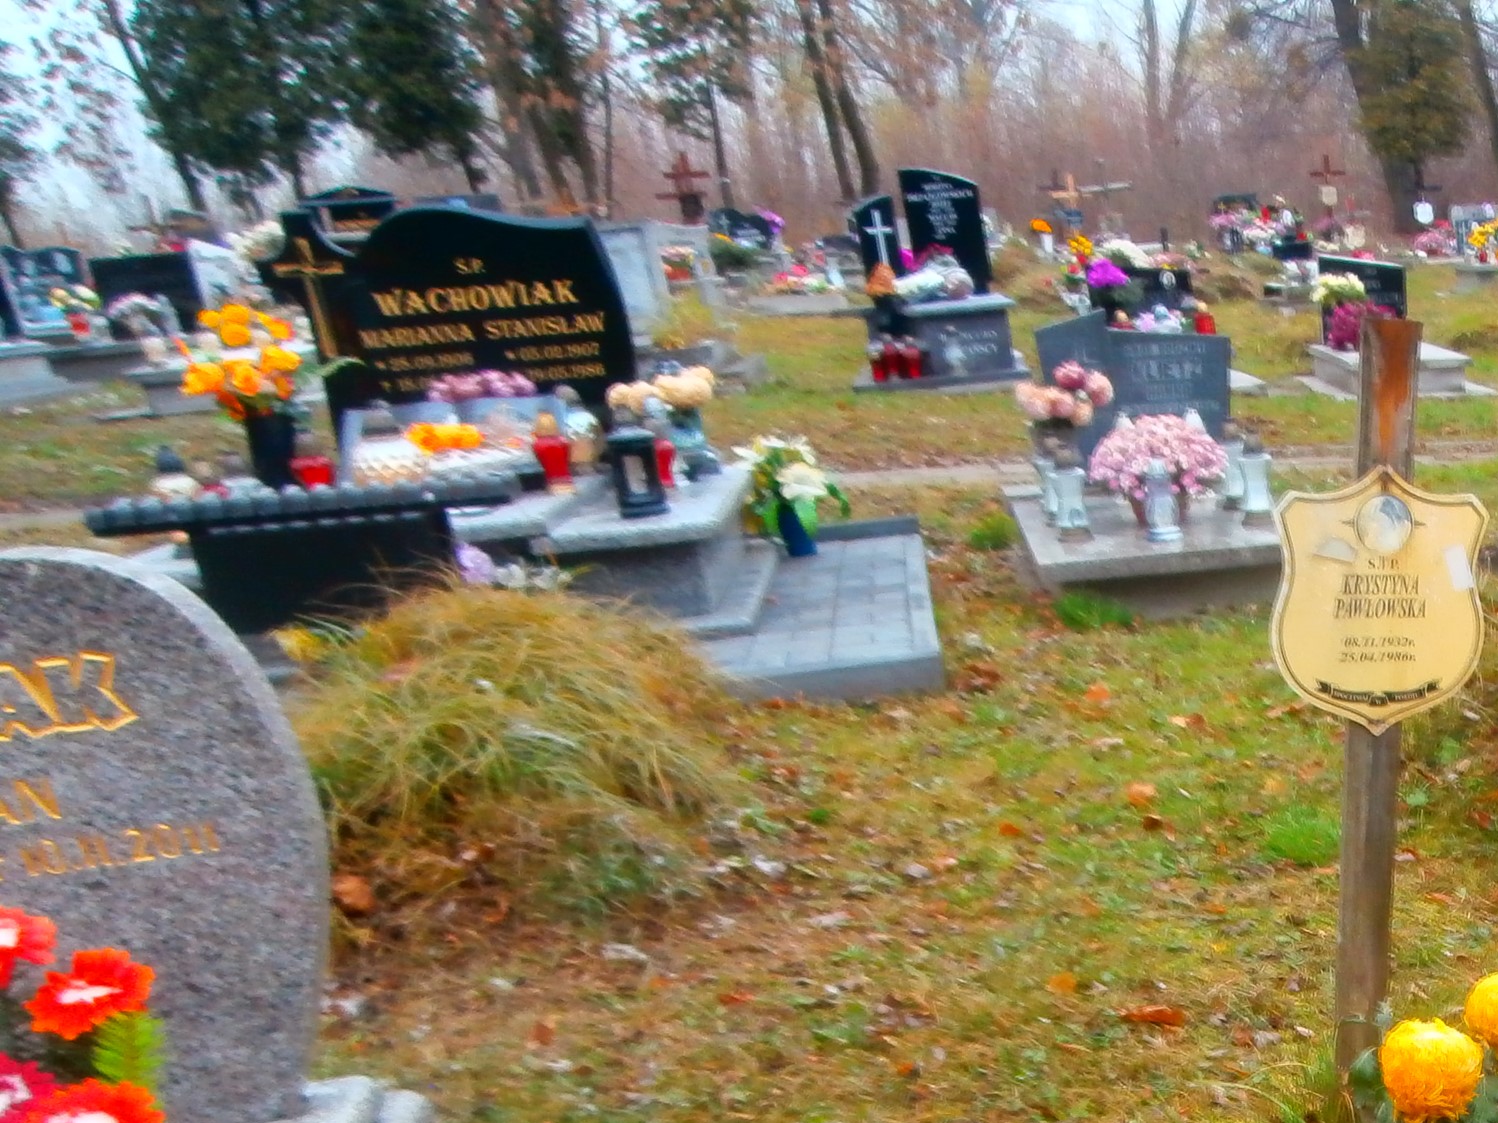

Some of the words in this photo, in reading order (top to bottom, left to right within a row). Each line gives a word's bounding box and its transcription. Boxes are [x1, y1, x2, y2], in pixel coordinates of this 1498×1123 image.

[372, 279, 578, 316] WACHOWIAK
[359, 324, 475, 348] MARIANNA
[1342, 574, 1420, 595] KRYSTYNA
[1333, 598, 1427, 619] PAWŁOWSKA
